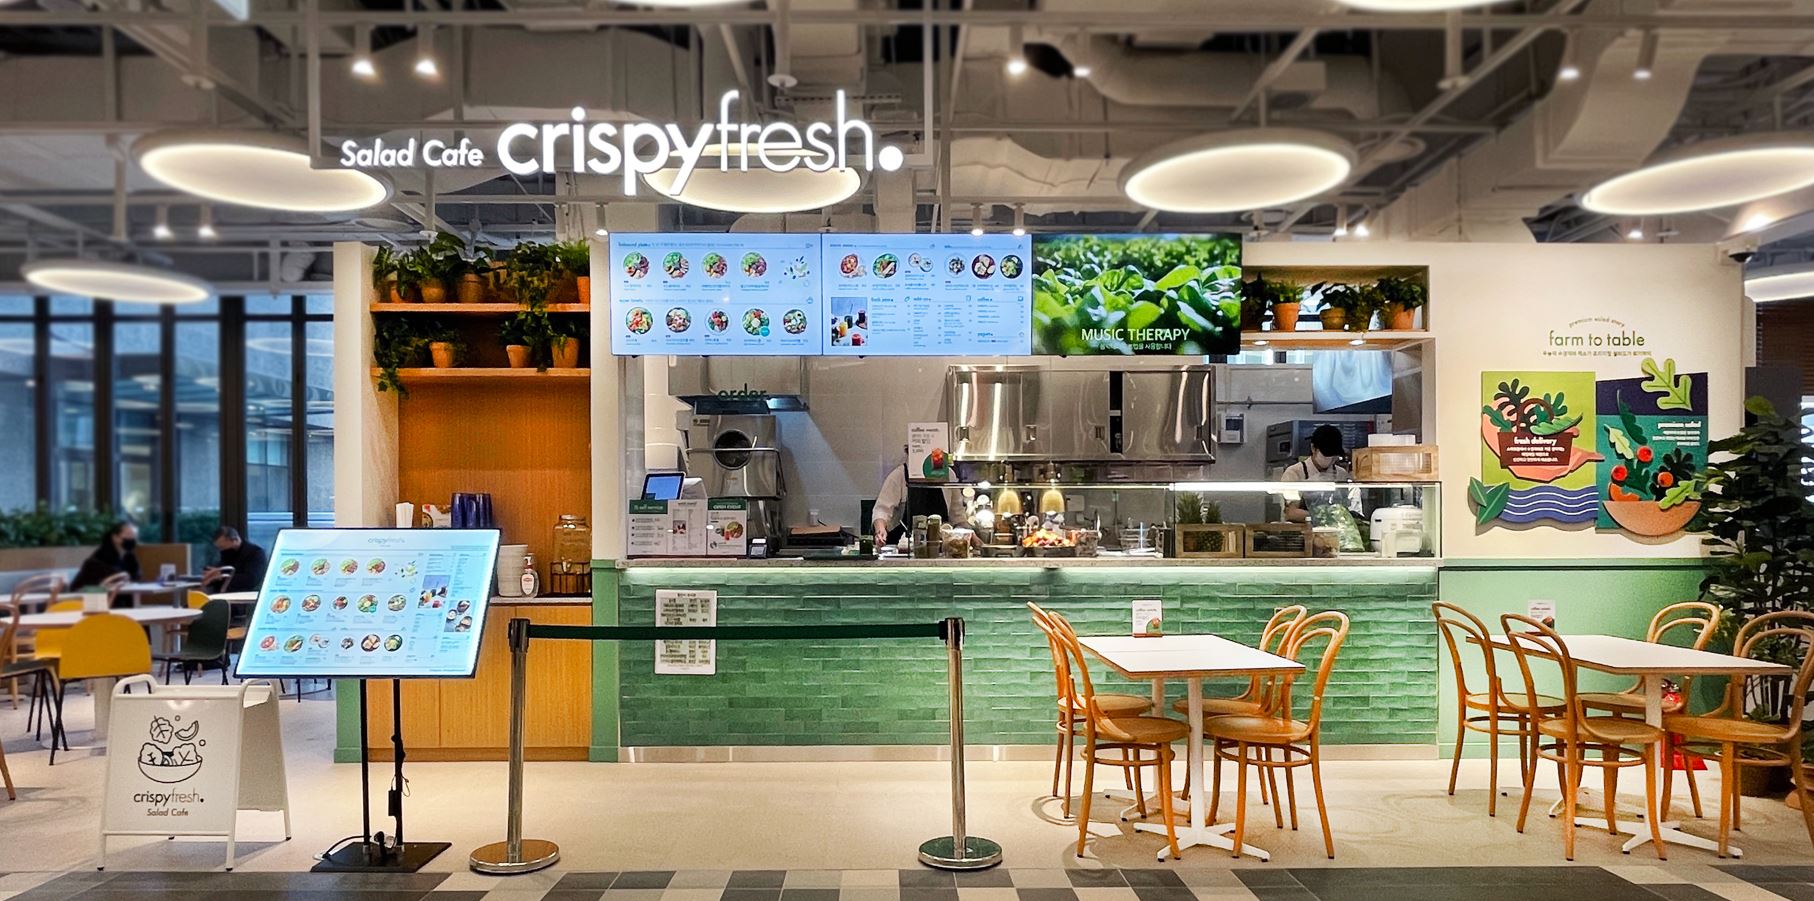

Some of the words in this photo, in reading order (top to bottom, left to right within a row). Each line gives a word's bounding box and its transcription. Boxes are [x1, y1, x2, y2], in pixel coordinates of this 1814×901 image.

[340, 138, 412, 167] Salad
[422, 138, 484, 167] Cafe
[1082, 328, 1124, 341] MUSIC
[1127, 328, 1190, 341] THERAPY
[1549, 330, 1584, 346] farm
[1589, 334, 1603, 346] to
[1607, 331, 1645, 346] table
[133, 788, 204, 806] crispyfresh.
[147, 808, 169, 816] Salad
[171, 808, 189, 816] Cafe
